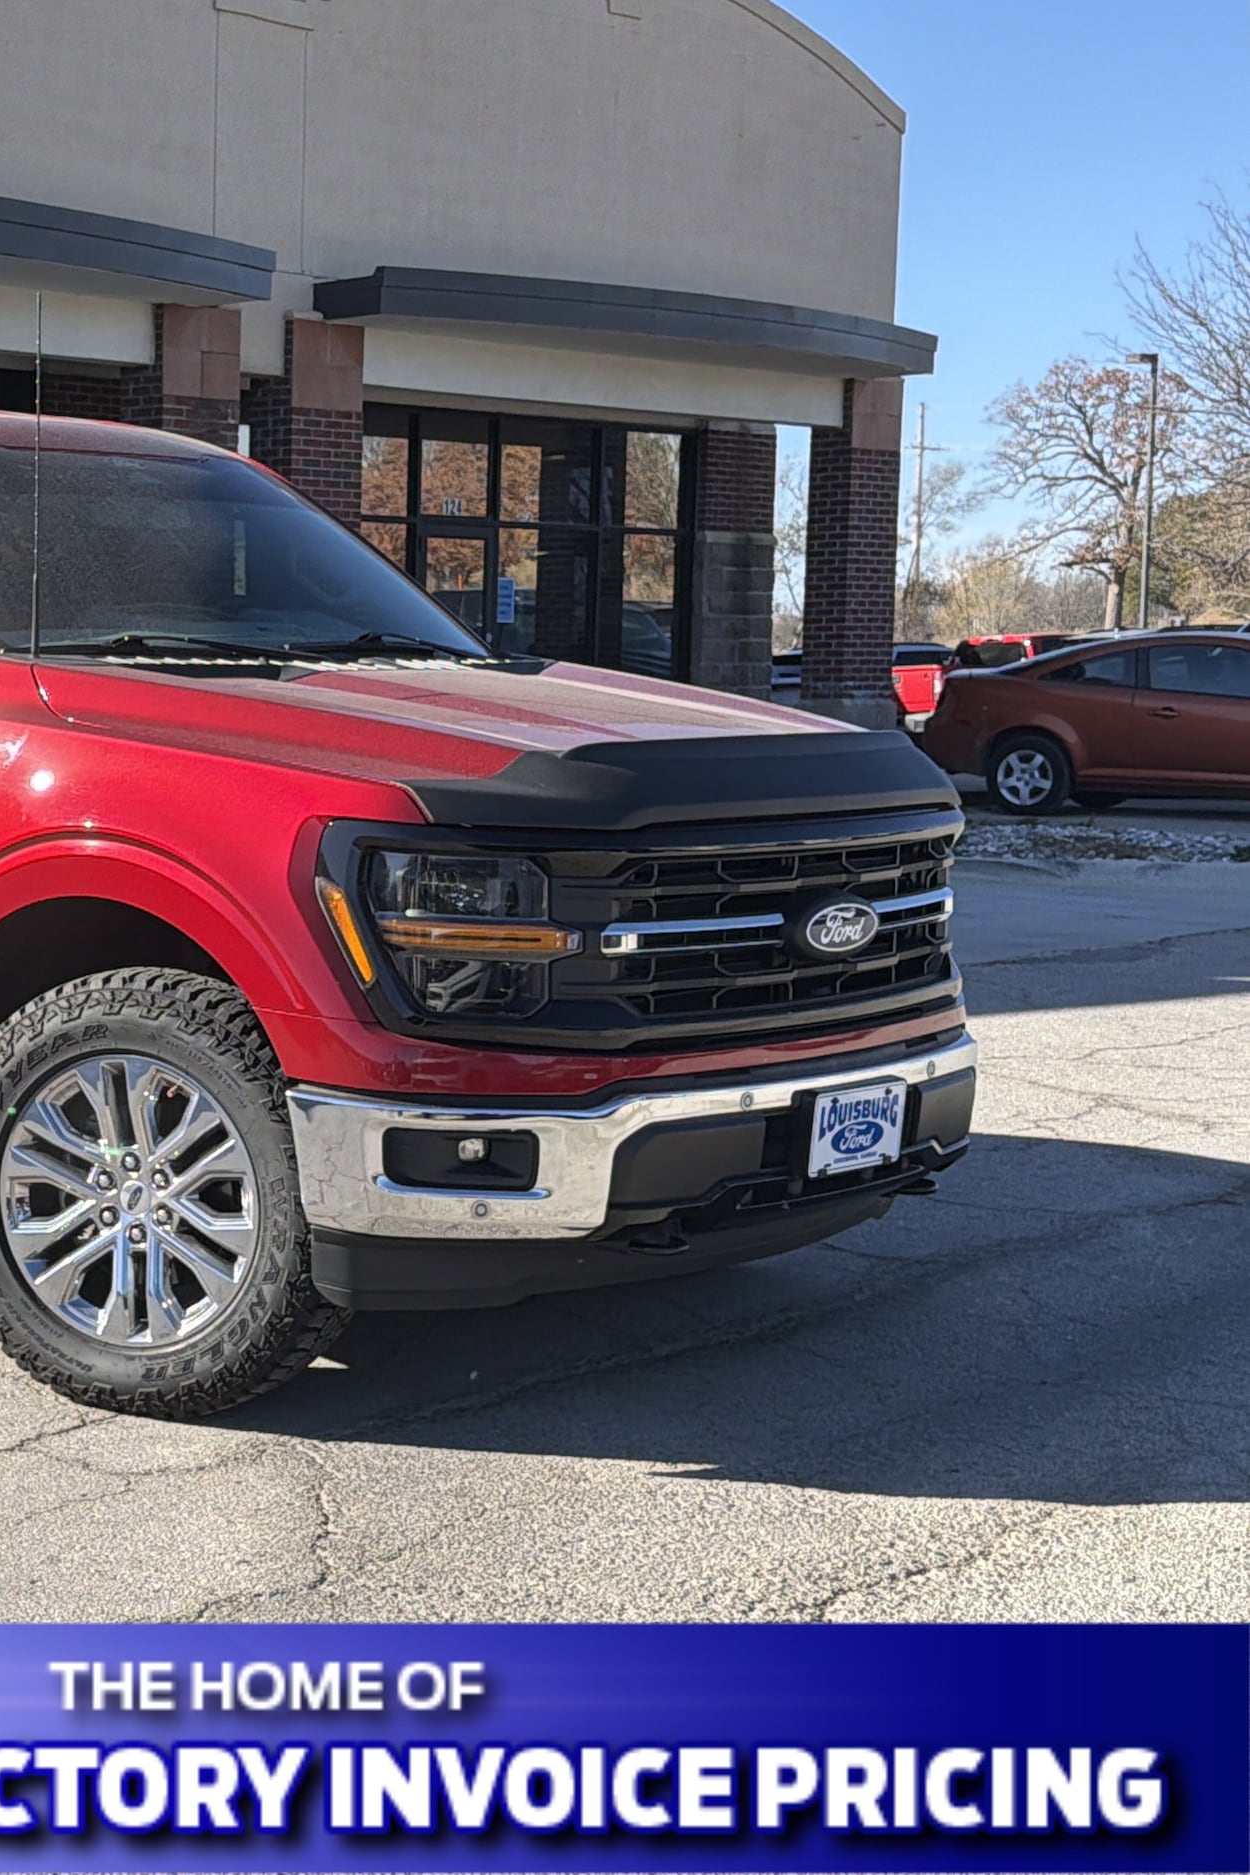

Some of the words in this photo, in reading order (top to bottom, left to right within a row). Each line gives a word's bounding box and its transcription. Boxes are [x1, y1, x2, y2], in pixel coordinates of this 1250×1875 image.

[820, 907, 866, 945] Ford
[818, 1093, 900, 1142] LOUISBURG
[839, 1124, 876, 1151] Ford
